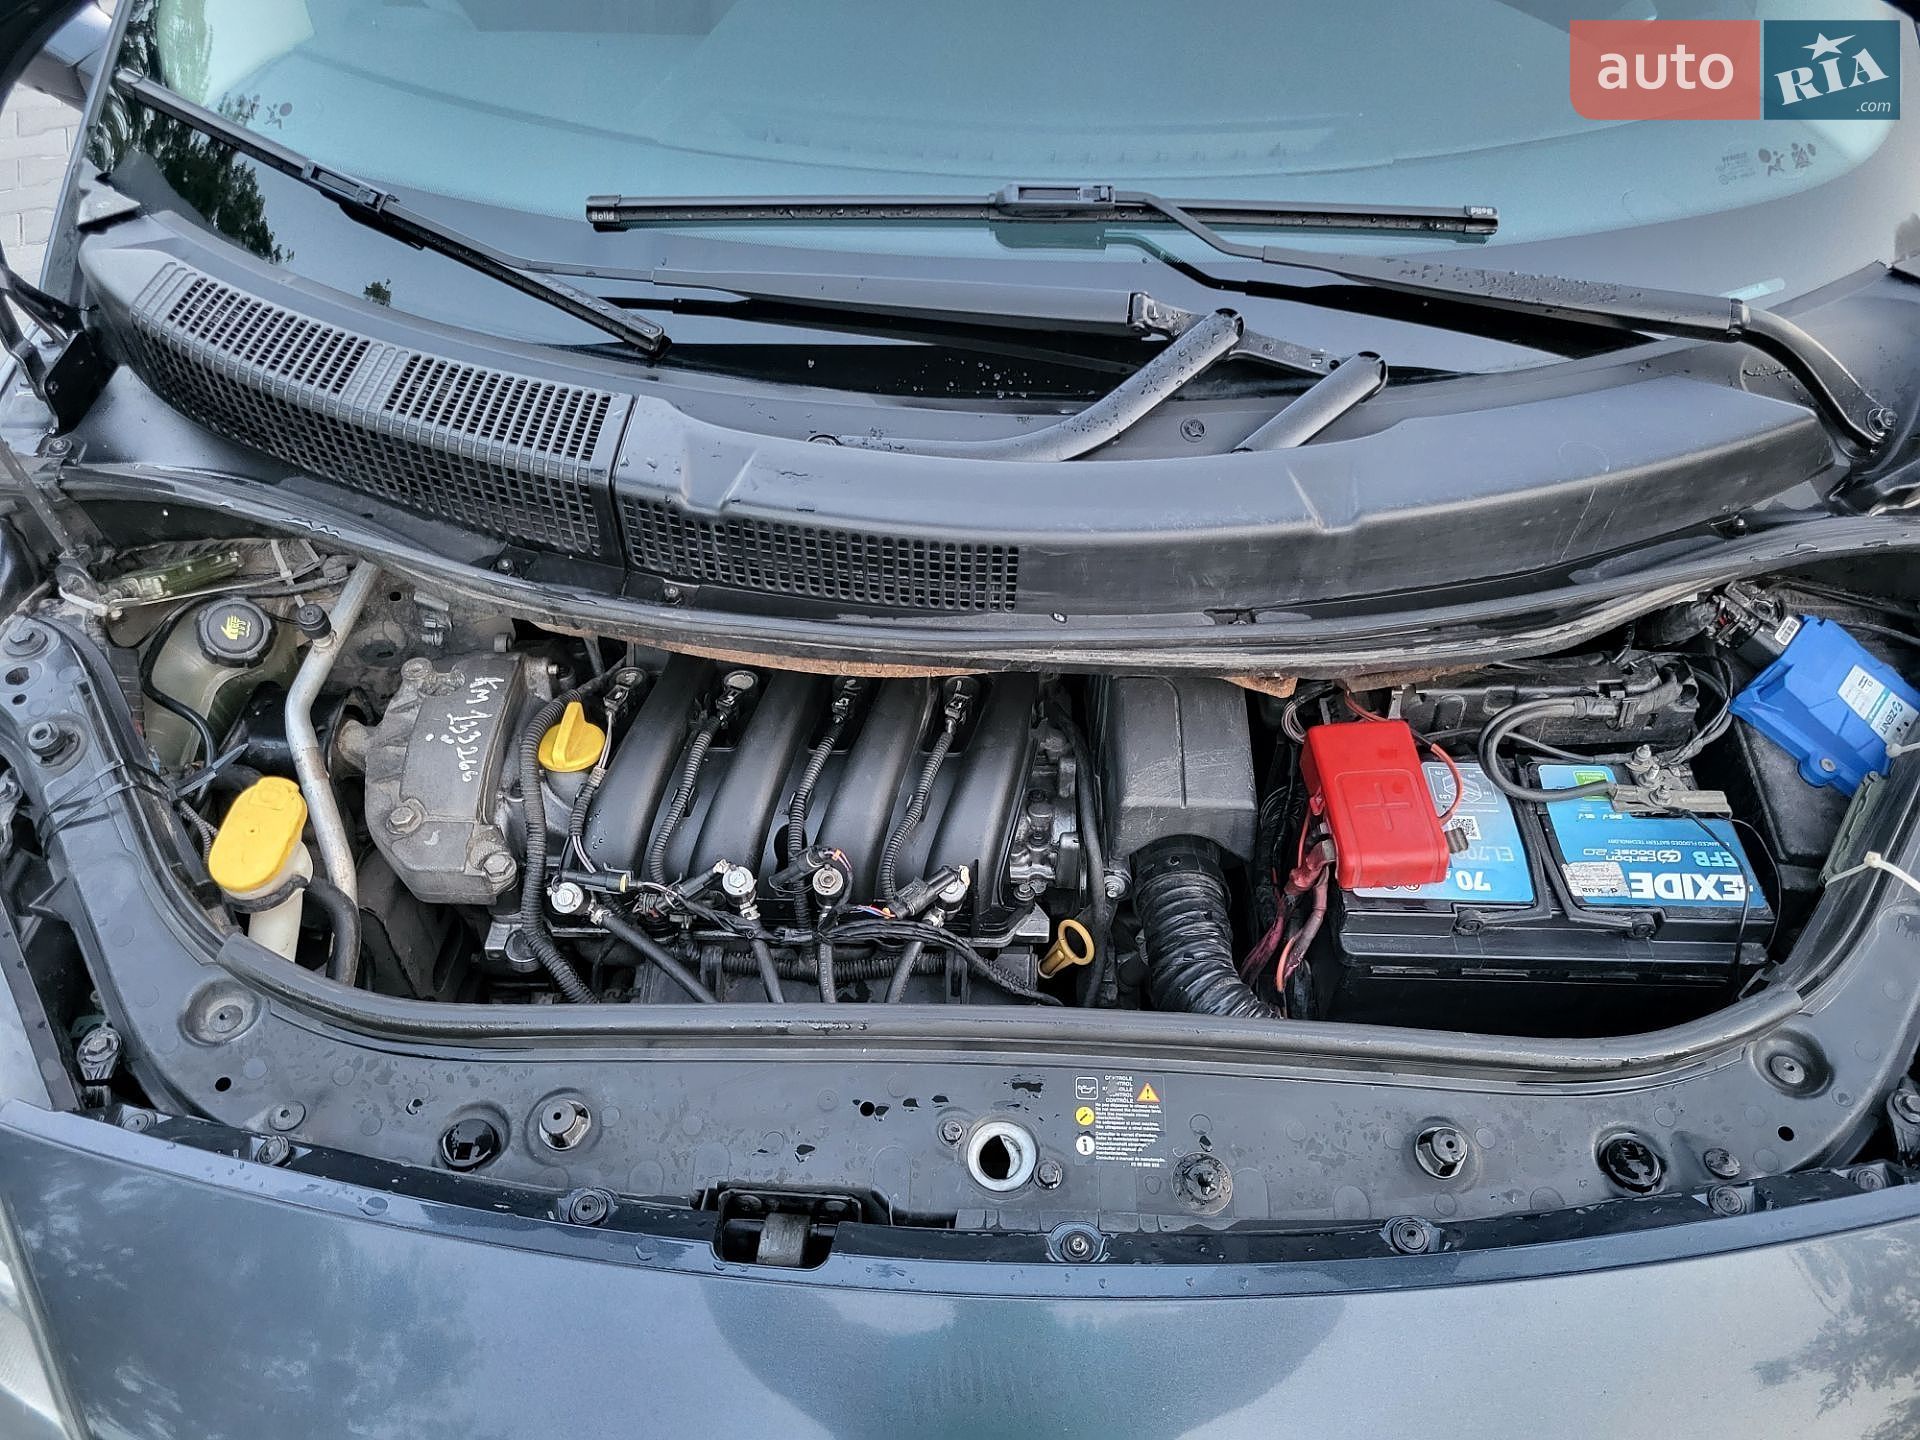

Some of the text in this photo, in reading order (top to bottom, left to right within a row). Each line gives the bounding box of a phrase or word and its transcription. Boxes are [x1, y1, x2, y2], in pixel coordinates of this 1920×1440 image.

[1693, 850, 1739, 868] EFB
[1455, 870, 1492, 892] 70
[1628, 872, 1747, 902] EXIDE
